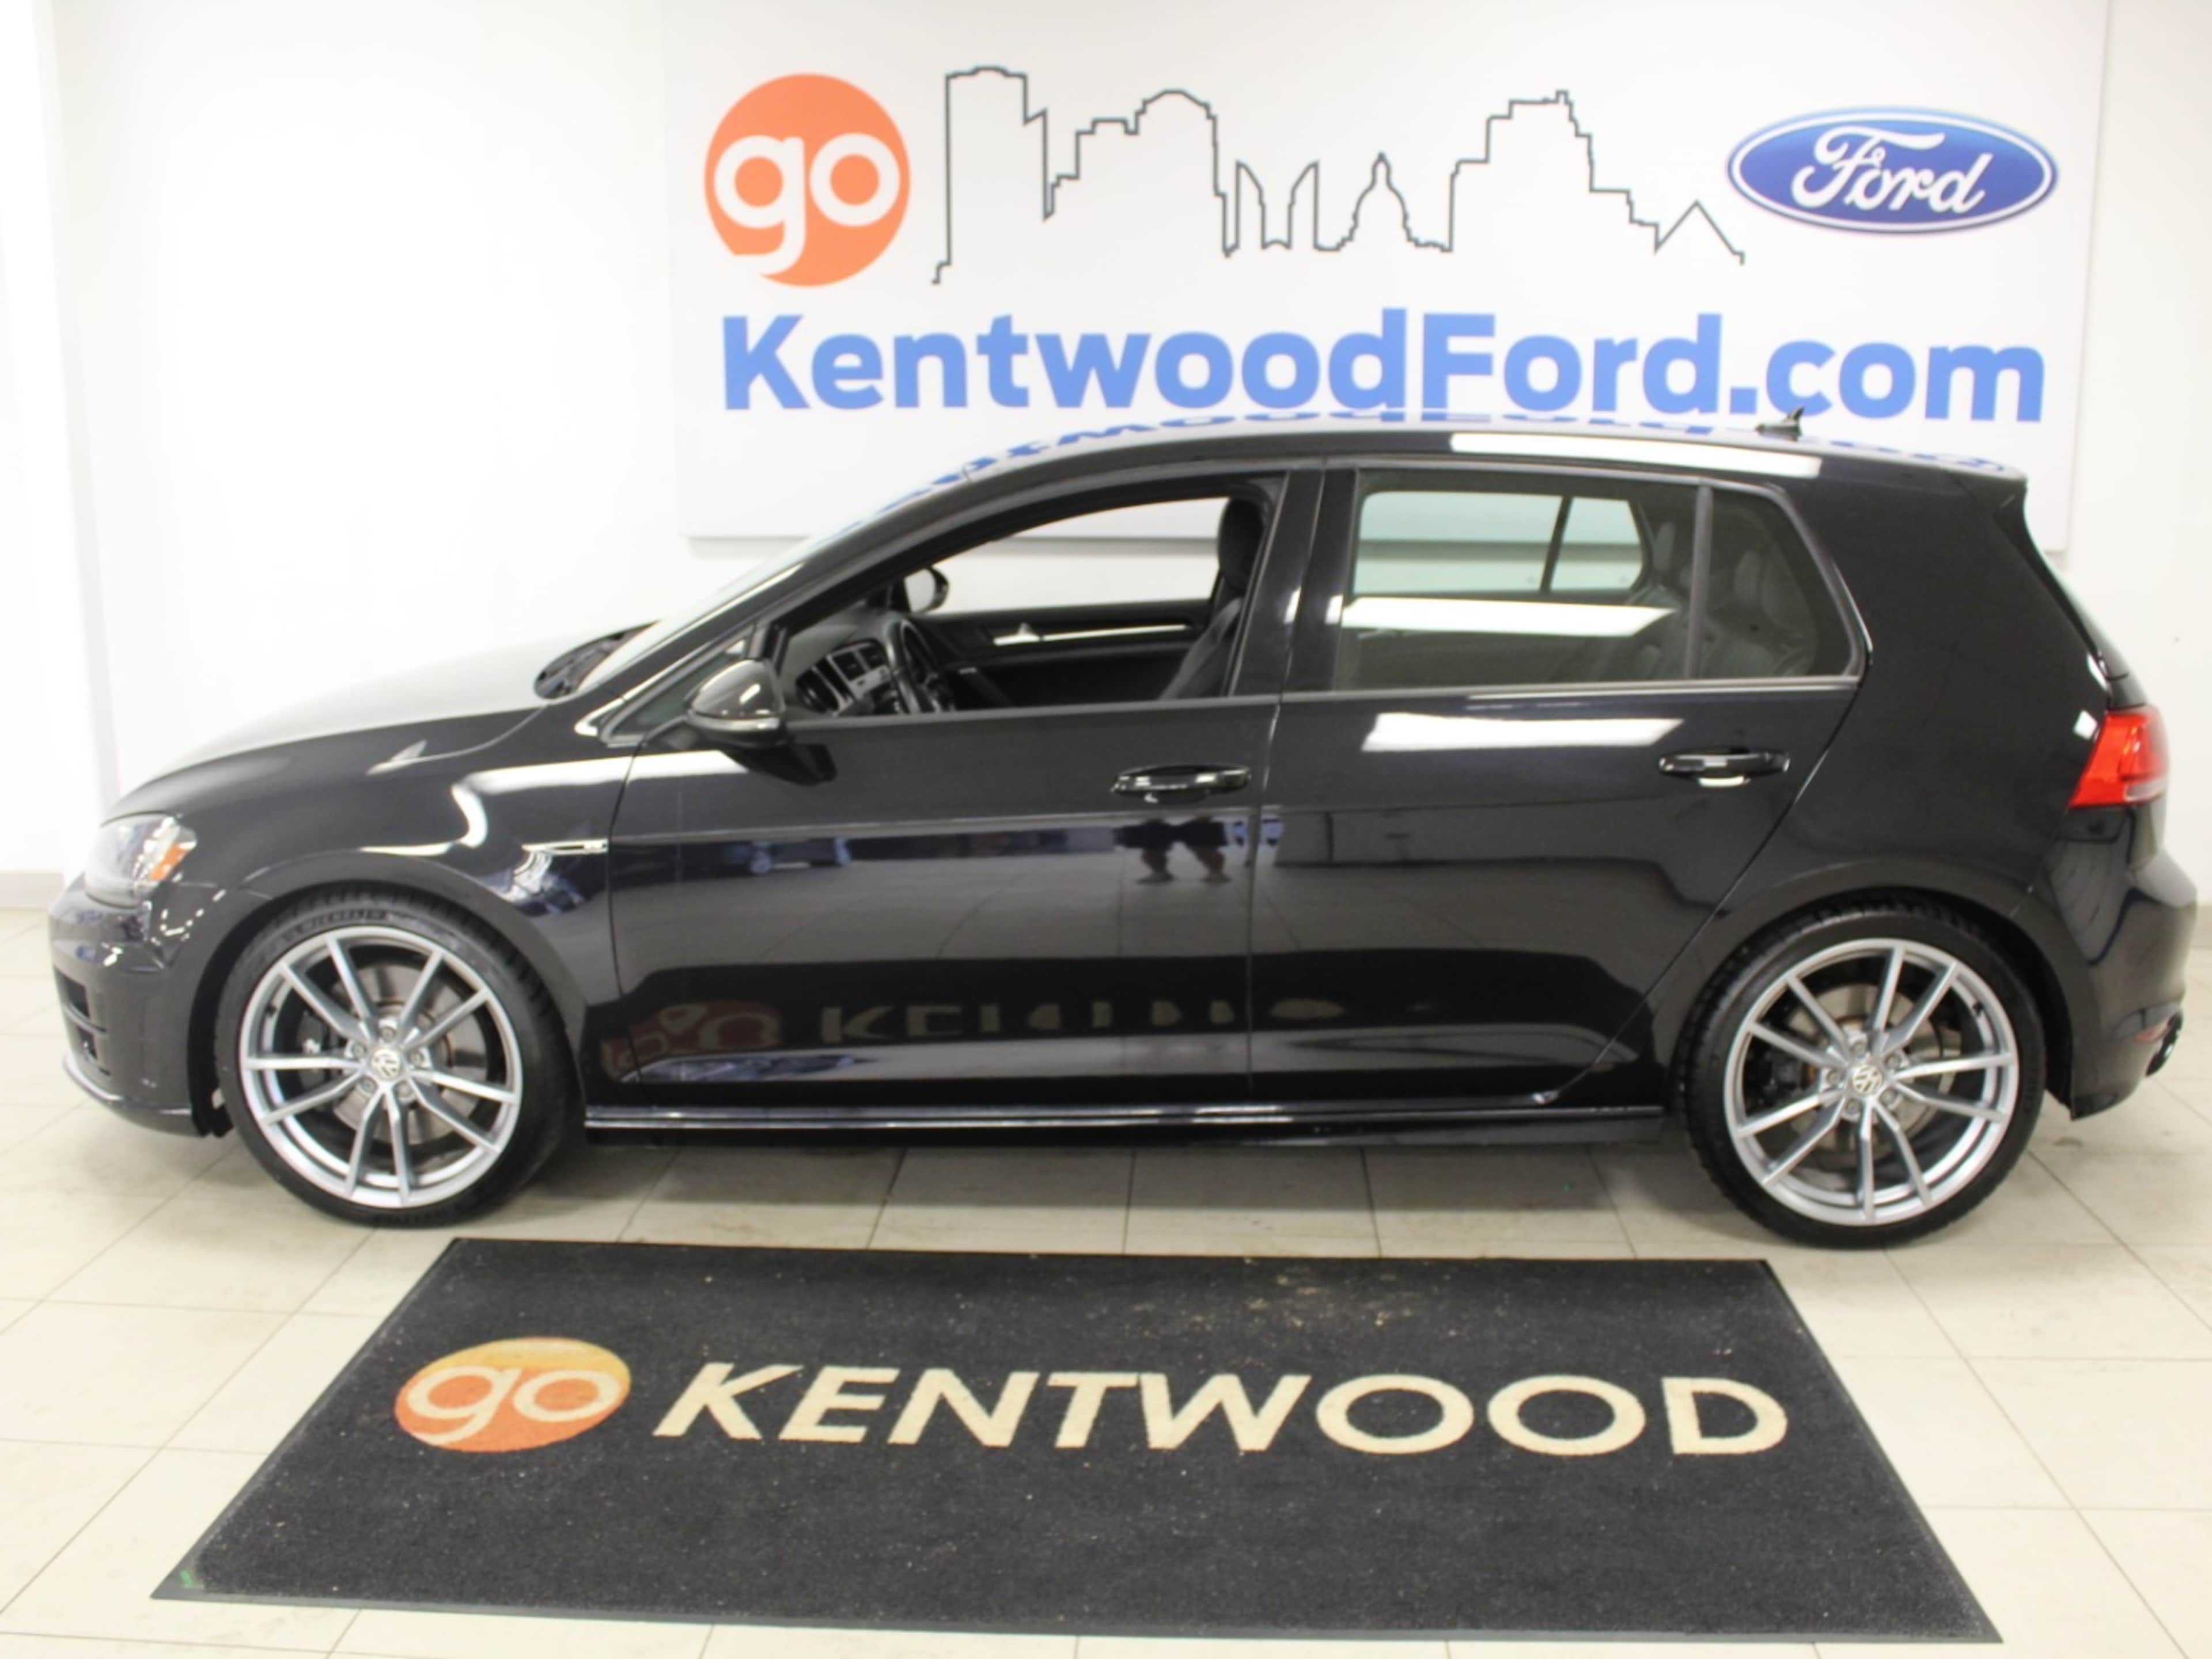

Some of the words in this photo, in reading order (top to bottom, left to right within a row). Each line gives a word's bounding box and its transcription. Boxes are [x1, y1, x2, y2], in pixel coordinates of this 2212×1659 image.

[713, 132, 901, 275] go
[1790, 125, 1994, 214] Ford
[722, 308, 2044, 422] KentwoodFord.com
[406, 1365, 621, 1445] go
[653, 1362, 1787, 1455] KENTWOOD
